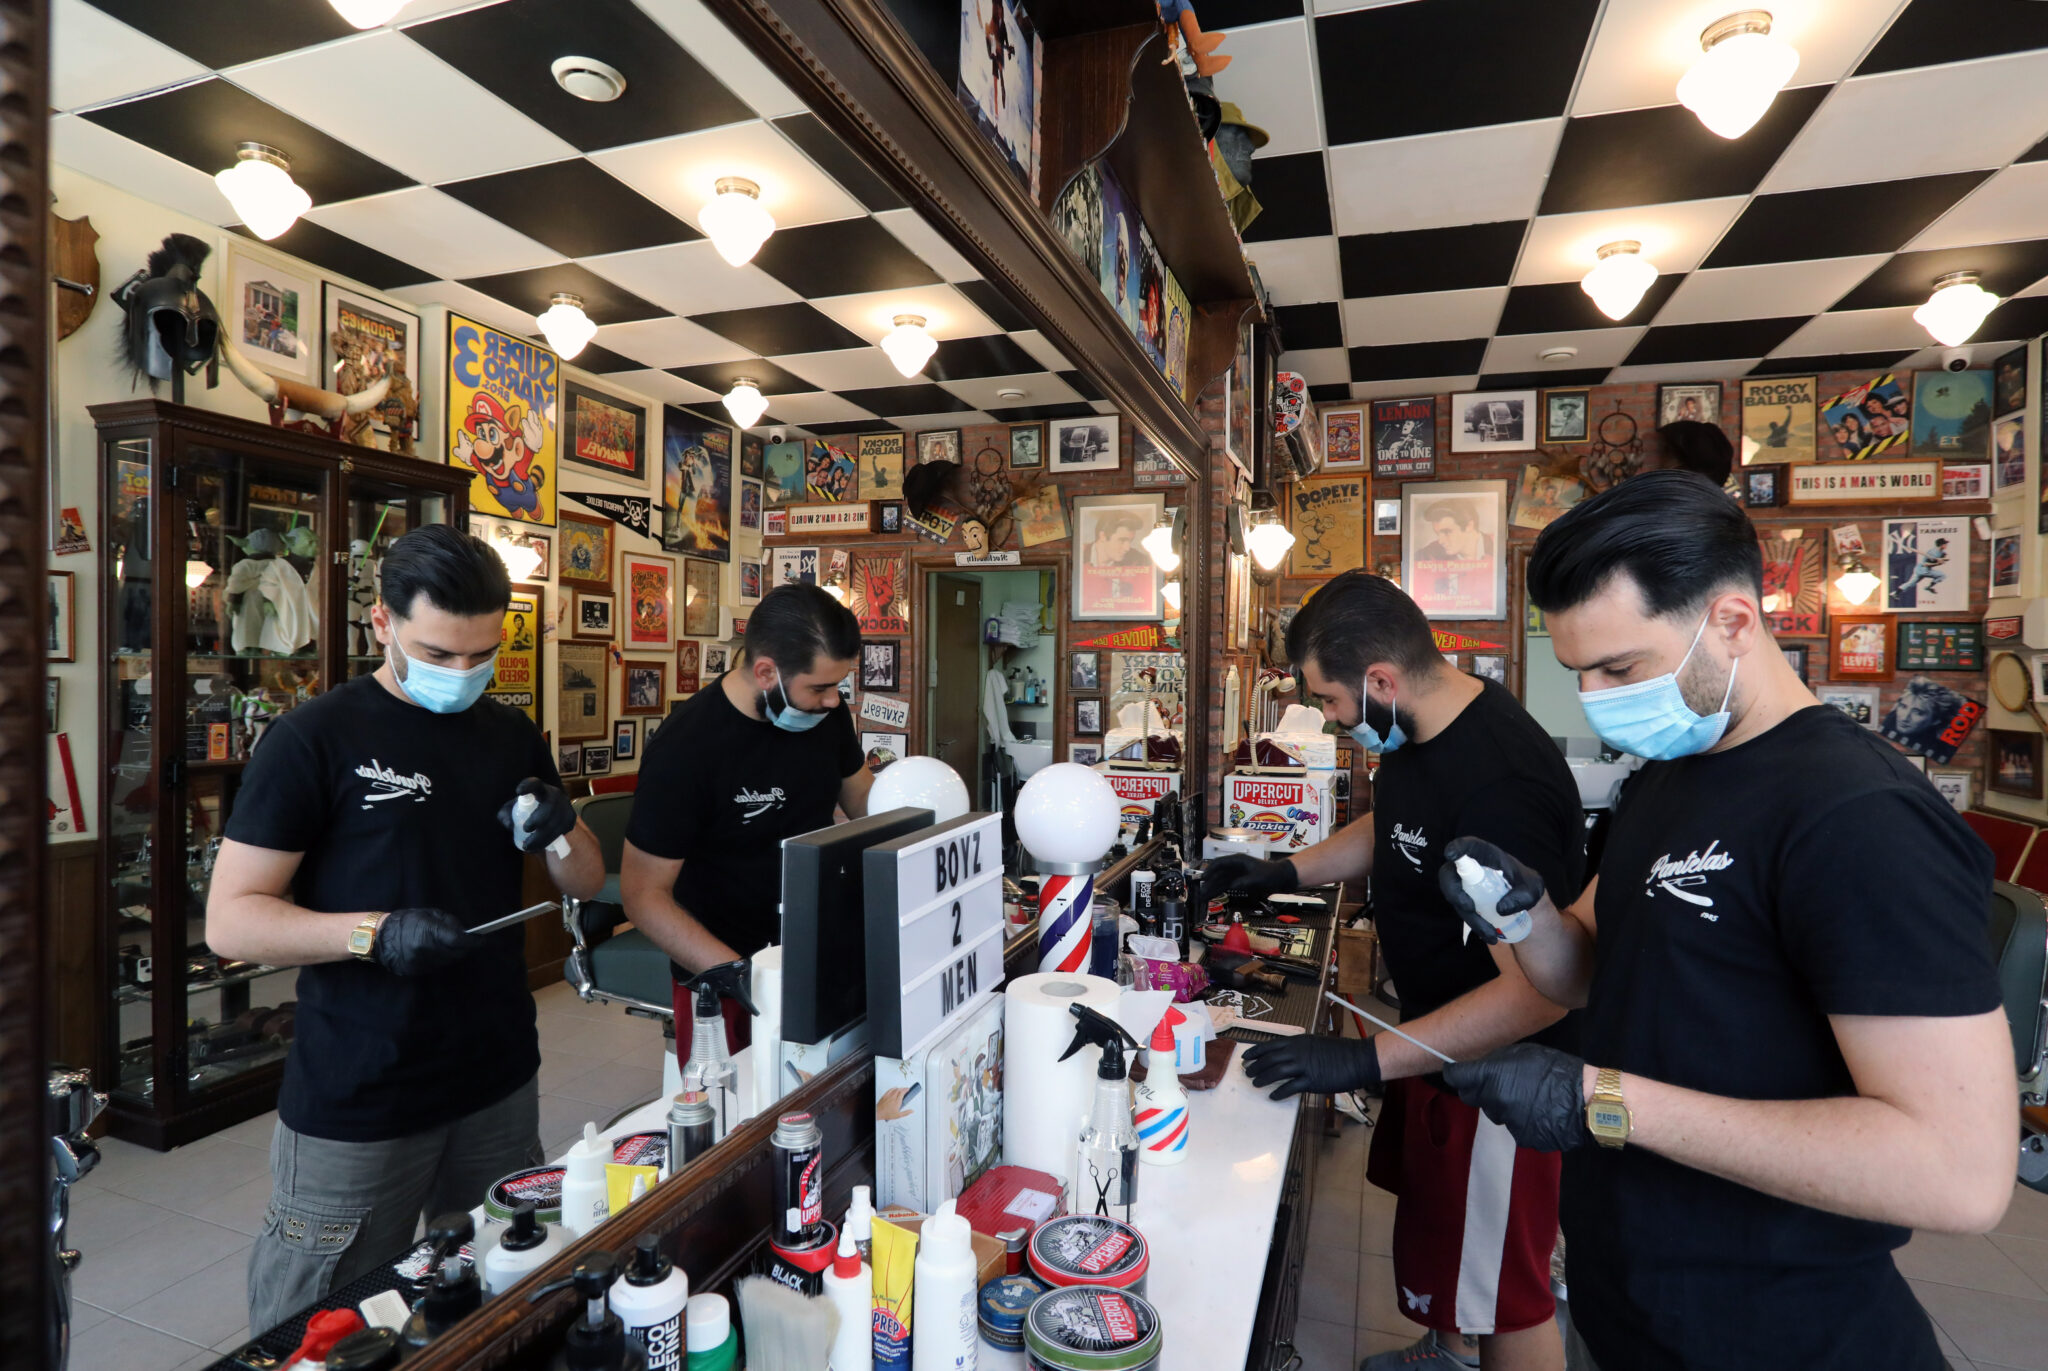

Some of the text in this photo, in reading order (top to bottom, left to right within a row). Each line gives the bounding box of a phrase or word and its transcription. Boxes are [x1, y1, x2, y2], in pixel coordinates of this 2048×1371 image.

[1749, 383, 1808, 396] ROCKY
[1744, 393, 1812, 407] BALBOA
[1378, 405, 1431, 421] LENNON
[1377, 446, 1432, 460] ONE TO ONE
[1378, 463, 1392, 471] NEW
[1395, 462, 1413, 471] YORK
[1416, 461, 1431, 470] CITY
[1795, 474, 1932, 489] THIS IS A MAN'S WORLD
[1295, 484, 1359, 512] POPEYE
[1920, 527, 1958, 535] YANKEES
[1766, 617, 1812, 631] OCK
[1432, 631, 1480, 649] VER DAM
[1940, 702, 1980, 748] ROD
[1235, 782, 1300, 803] UPPERCUT
[1257, 798, 1278, 806] DELUXE
[1286, 806, 1320, 825] OOPS
[1244, 821, 1292, 832] Dickies
[936, 830, 981, 893] BOYZ
[1645, 840, 1735, 884] Pantelas
[951, 901, 962, 948] 2
[1163, 922, 1184, 941] HD
[942, 951, 978, 1017] MEN
[1081, 1232, 1131, 1273] UPPERCUT
[771, 1263, 803, 1291] BLACK
[873, 1311, 900, 1336] PREP
[1100, 1295, 1136, 1340] UPPERCUT
[648, 1324, 665, 1369] ECO
[665, 1315, 680, 1371] EFINE
